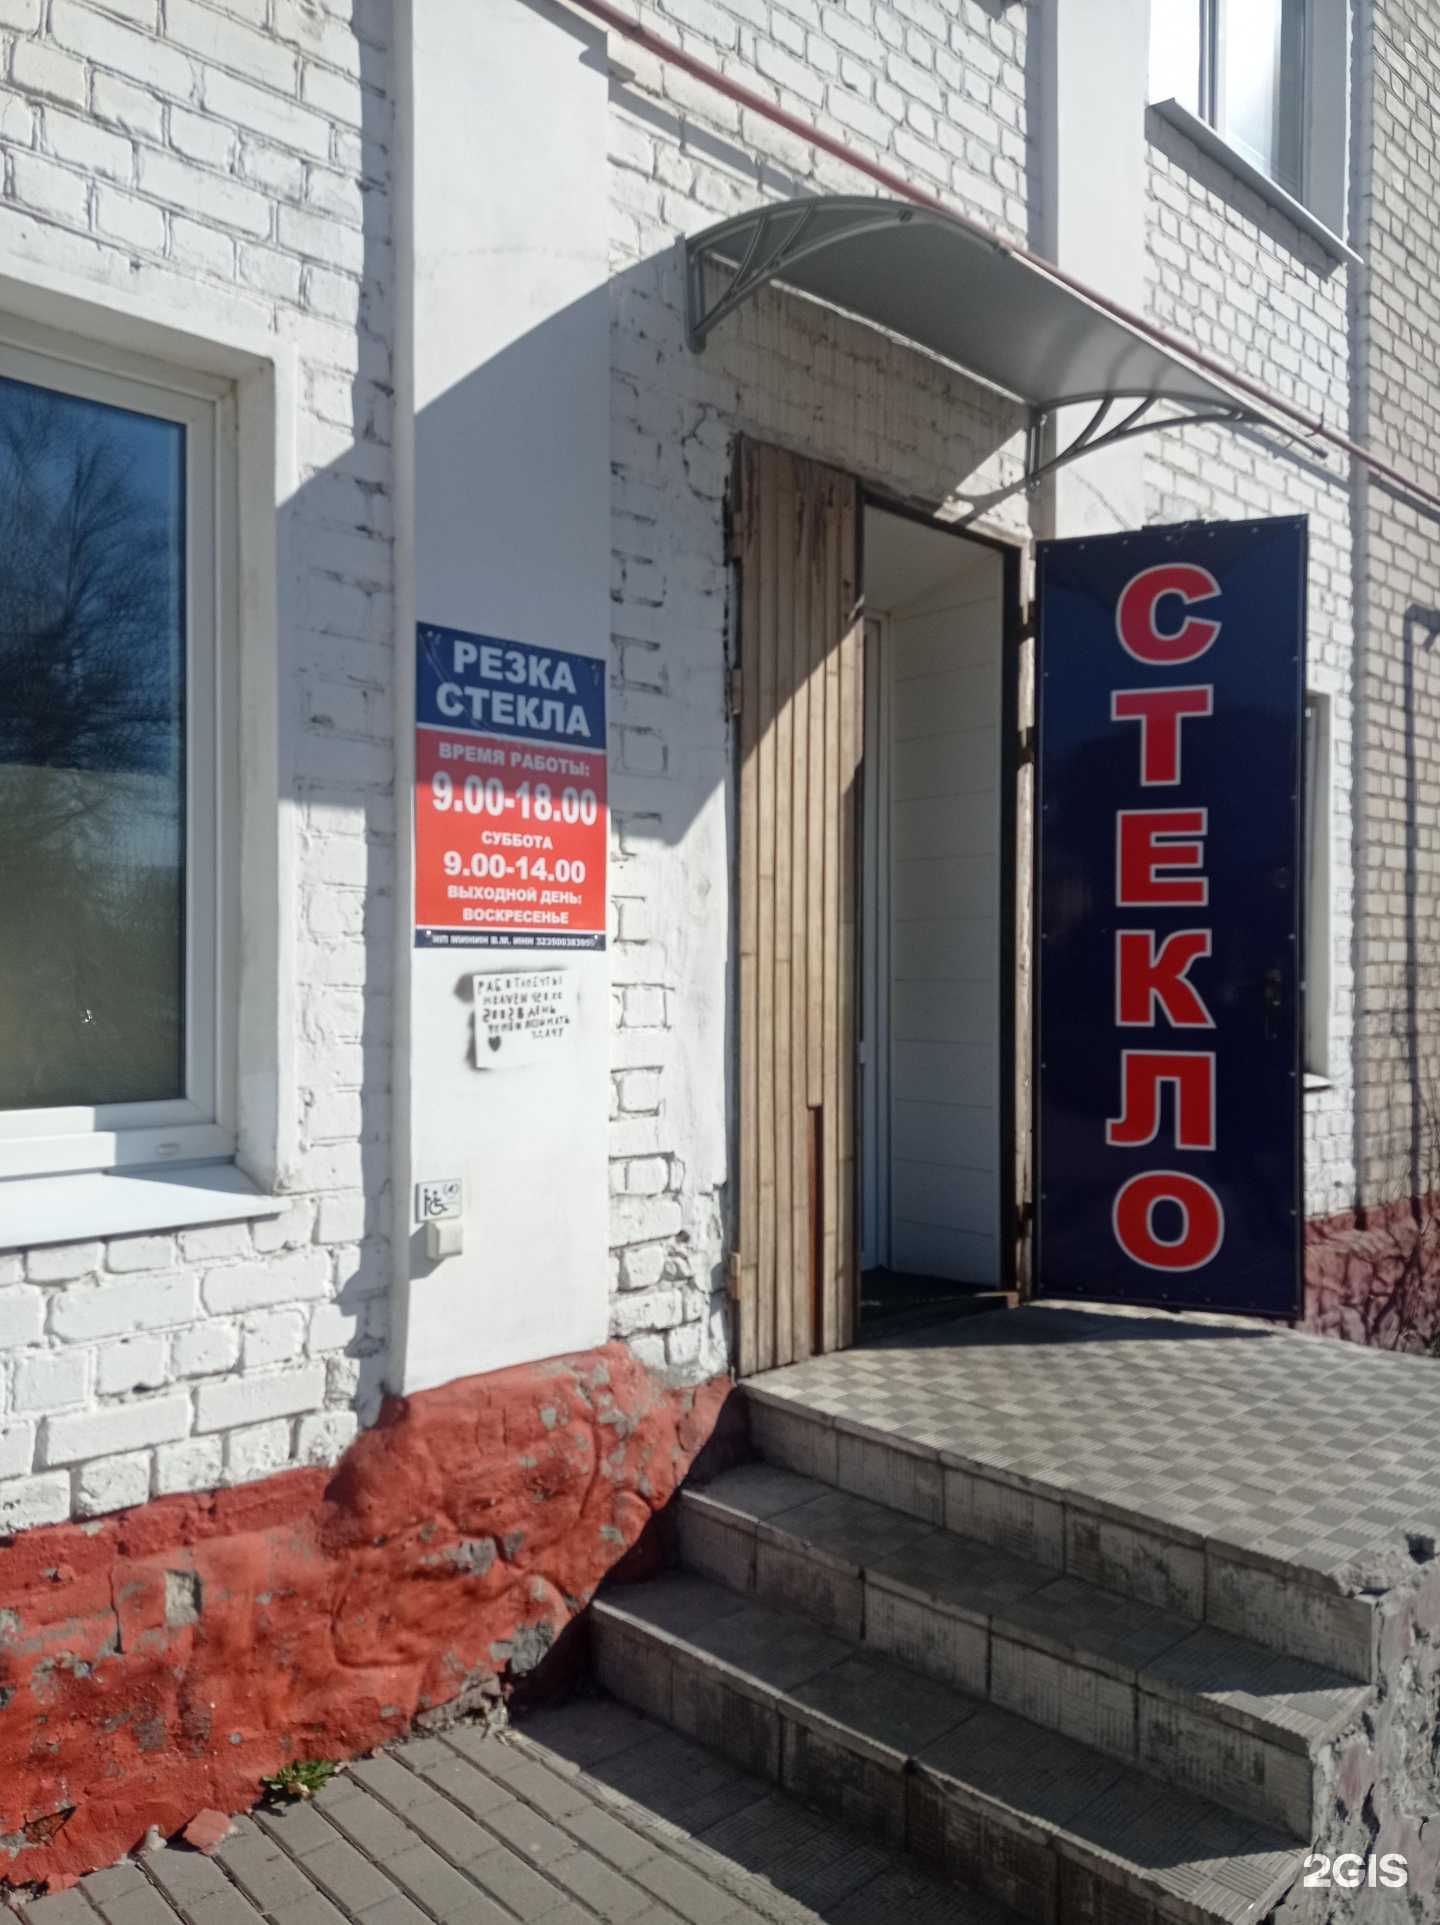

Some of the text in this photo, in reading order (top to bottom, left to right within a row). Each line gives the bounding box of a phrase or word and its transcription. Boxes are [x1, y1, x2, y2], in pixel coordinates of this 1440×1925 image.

[453, 639, 577, 694] РЕЗКА
[436, 681, 592, 738] СТЕКЛА
[438, 742, 591, 777] ВРЕМЯ РАБОТЫ:
[432, 770, 598, 826] 9.00-18.00
[481, 830, 553, 850] СУББОТА
[443, 850, 586, 884] 9.00-14.00
[447, 885, 582, 905] ВЫХОДНОЙ ДЕНЬ:
[462, 908, 569, 925] ВОСКРЕСЕНЬЕ
[1106, 562, 1225, 1272] СТЕКЛО
